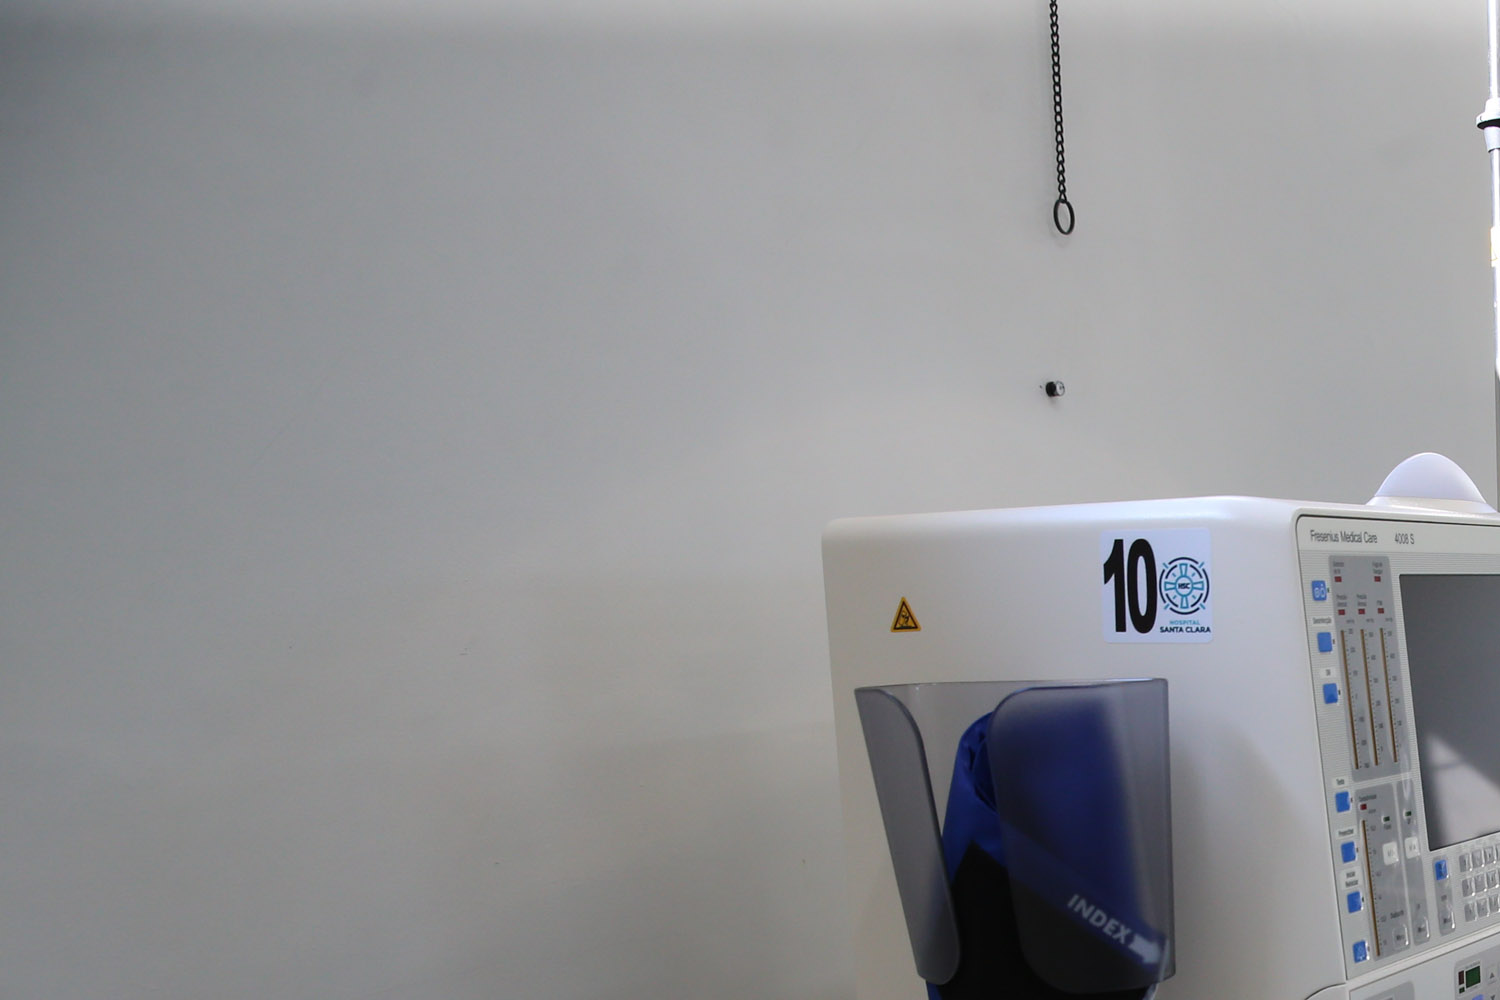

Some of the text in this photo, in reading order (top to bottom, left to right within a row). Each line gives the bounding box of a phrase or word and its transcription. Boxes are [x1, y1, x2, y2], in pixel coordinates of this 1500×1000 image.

[1310, 529, 1415, 545] Fresenius Medical Care 4008 S
[1103, 538, 1158, 634] 10
[1178, 582, 1191, 590] HSC
[1067, 893, 1132, 945] INDEX
